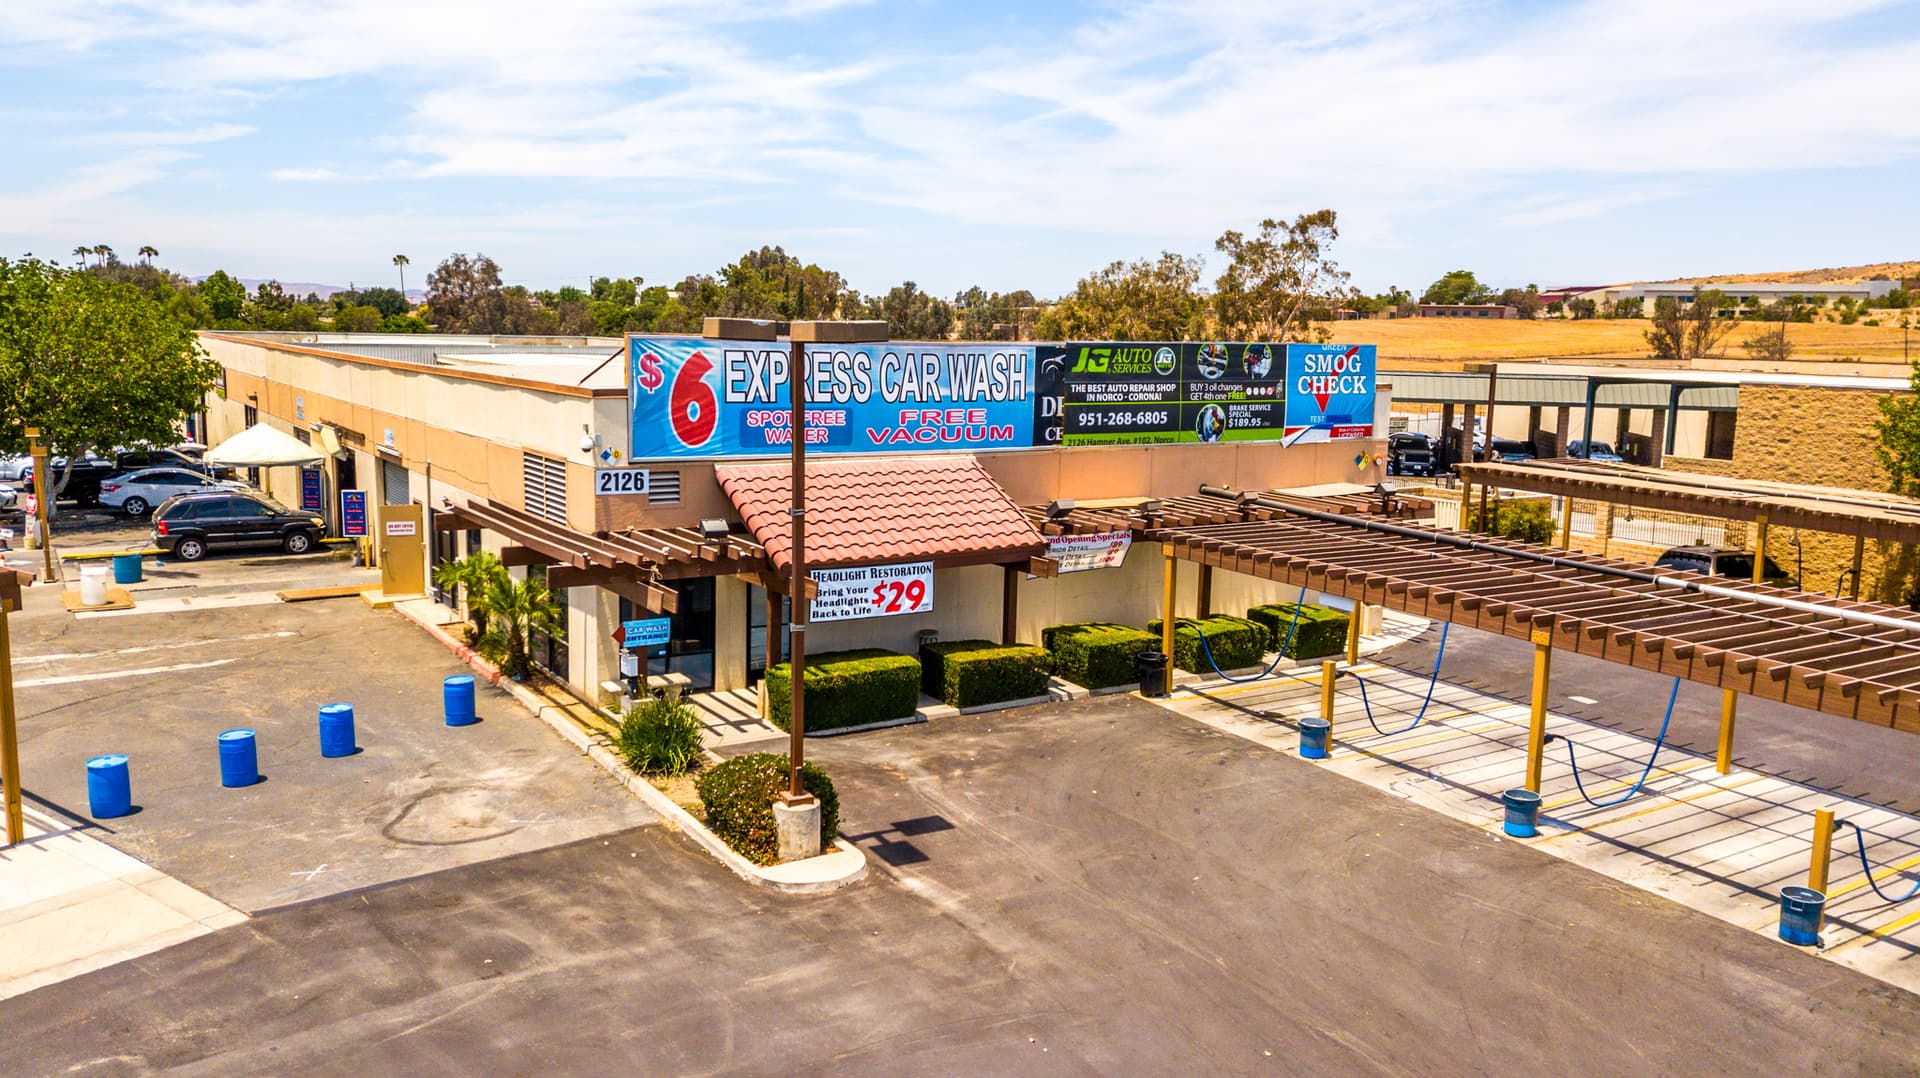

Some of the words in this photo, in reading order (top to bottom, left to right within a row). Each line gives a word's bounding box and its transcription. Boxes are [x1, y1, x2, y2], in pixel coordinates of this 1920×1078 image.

[1112, 348, 1152, 363] AUTO
[1112, 363, 1153, 374] SERVICES
[1304, 353, 1362, 373] SMOG
[880, 352, 941, 403] CAR
[947, 353, 1027, 402] WASH
[1071, 384, 1086, 393] THE
[1087, 384, 1106, 393] BEST
[1107, 384, 1128, 393] AUTO
[1129, 384, 1155, 393] REPAIR
[1156, 383, 1177, 392] SHOP
[1190, 383, 1203, 392] BUY
[1218, 383, 1243, 394] changes
[1298, 375, 1368, 395] CHECK
[1086, 393, 1095, 402] IN
[1096, 393, 1123, 402] NORCO
[1190, 392, 1203, 400] GET
[1203, 392, 1214, 400] 4th
[1249, 403, 1272, 411] SERVICE
[899, 409, 987, 426] FREE
[1079, 411, 1168, 427] 951-268-6805
[1228, 417, 1261, 428] $189.95
[765, 428, 829, 444] WAER
[866, 425, 1014, 445] VACUUM
[600, 471, 645, 492] 2126
[1061, 535, 1097, 545] Opening
[813, 570, 867, 583] HEADLIGHT
[870, 564, 932, 579] RESTORATION
[817, 588, 844, 598] Bring
[847, 586, 869, 595] Your
[872, 579, 926, 613] $29
[815, 597, 869, 608] Headlights
[812, 608, 838, 618] Back
[840, 608, 850, 617] to
[853, 606, 872, 616] Life
[627, 626, 643, 634] CAR
[646, 625, 668, 633] WASH
[626, 632, 668, 642] ENTRANCE
